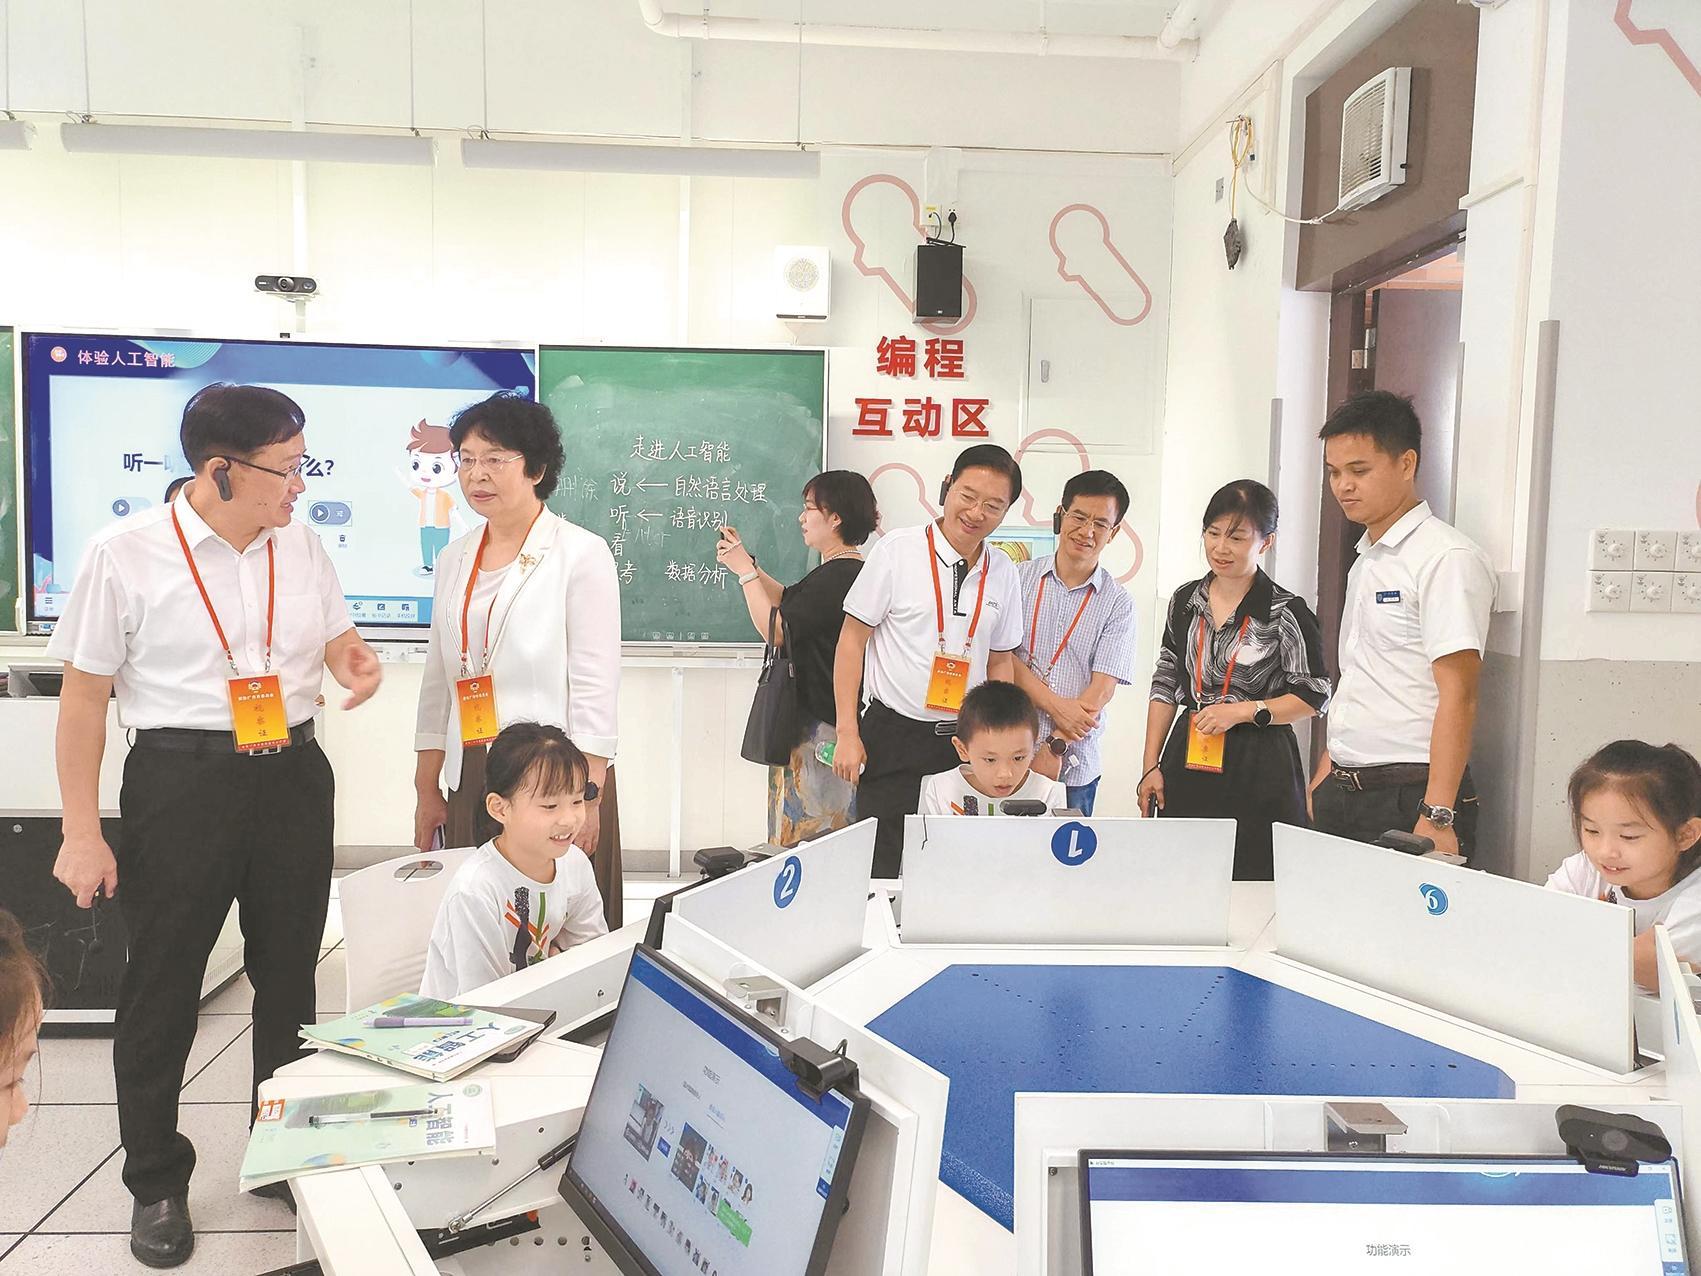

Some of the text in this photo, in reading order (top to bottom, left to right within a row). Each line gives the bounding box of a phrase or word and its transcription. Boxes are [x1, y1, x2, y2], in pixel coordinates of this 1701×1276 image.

[78, 350, 176, 368] 体验人工智能
[876, 335, 965, 378] 编程
[852, 396, 989, 438] 互动区
[123, 453, 174, 473] 听一
[630, 435, 731, 463] 走进人工智能
[610, 471, 769, 504] 说 自然语言处理
[609, 504, 728, 532] 听 语音识别
[610, 533, 628, 557] 看
[614, 560, 729, 590] 考 数据分析
[780, 864, 796, 900] 2
[413, 1021, 501, 1063] 人工智能
[1366, 1243, 1412, 1257] 功能演示
